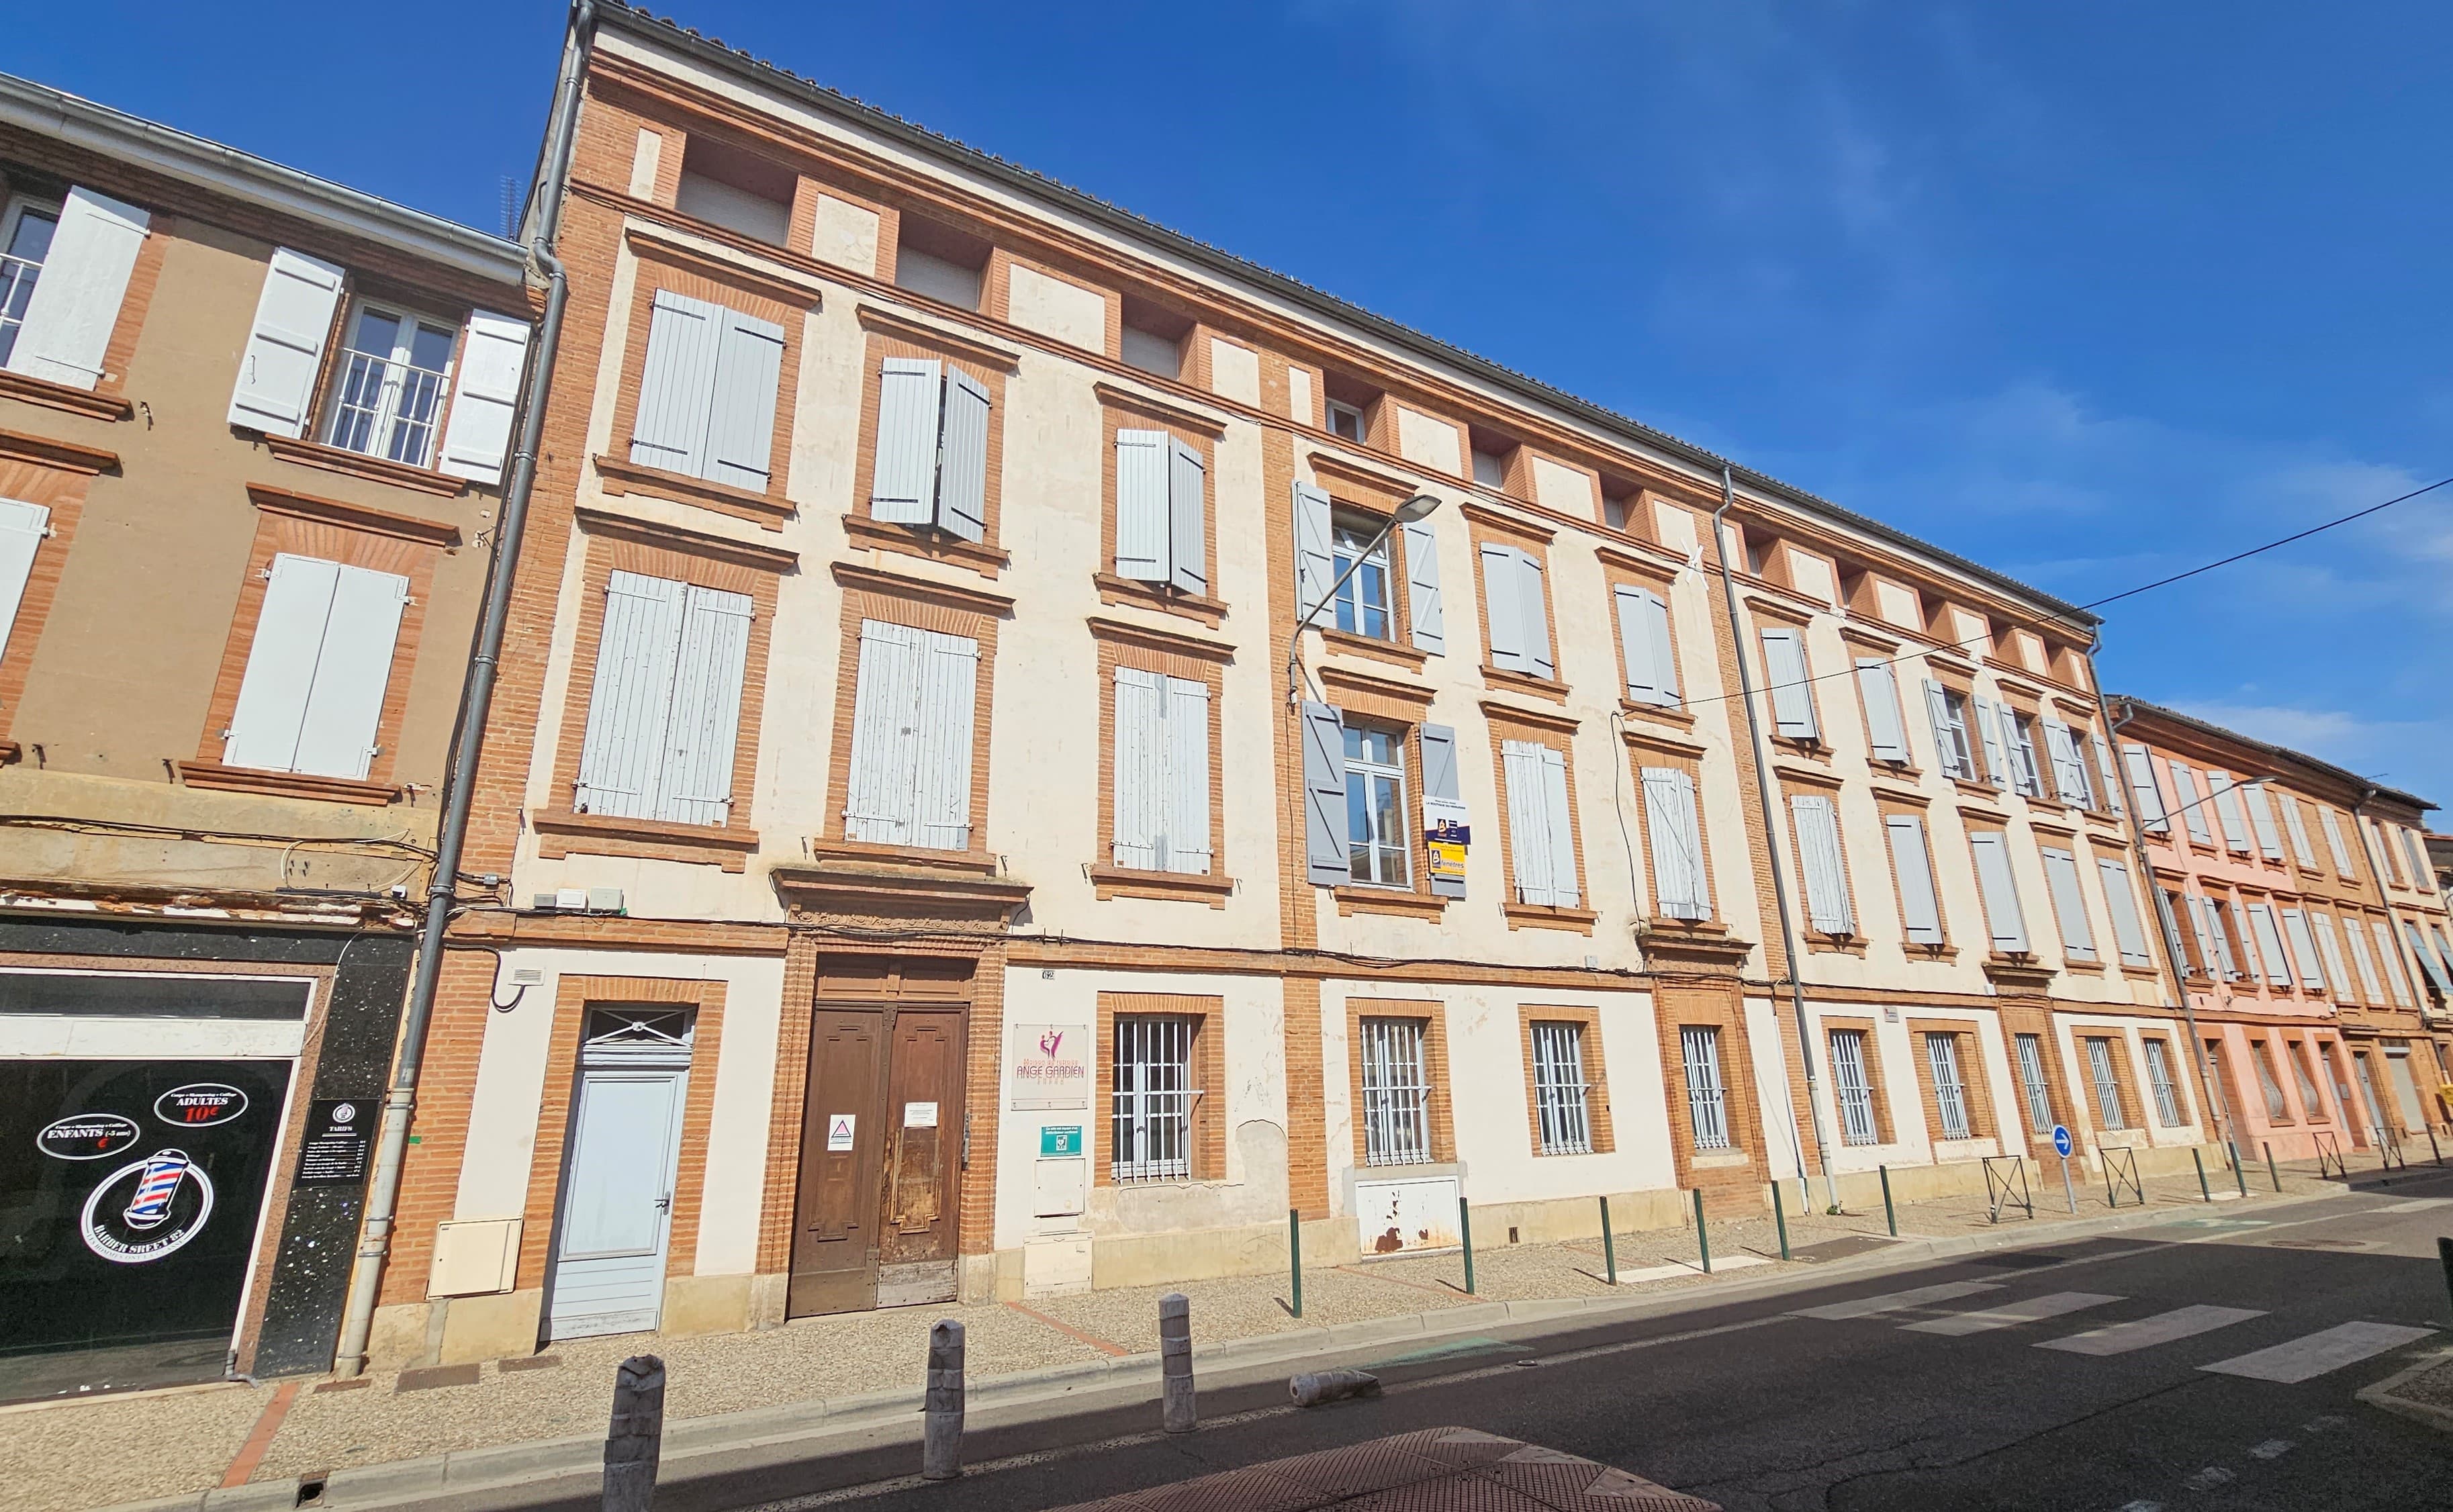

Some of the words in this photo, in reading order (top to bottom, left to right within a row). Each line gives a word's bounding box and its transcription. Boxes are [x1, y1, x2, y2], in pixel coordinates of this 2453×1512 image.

[1017, 1066, 1043, 1078] ANGE
[1046, 1066, 1084, 1078] GARDIEN
[176, 1097, 228, 1106] ADULTES
[185, 1106, 220, 1122] 10€
[47, 1129, 103, 1139] ENFANTS
[97, 1137, 109, 1147] €
[93, 1224, 128, 1253] BARBER
[128, 1238, 169, 1254] SREET
[170, 1229, 185, 1241] 82
